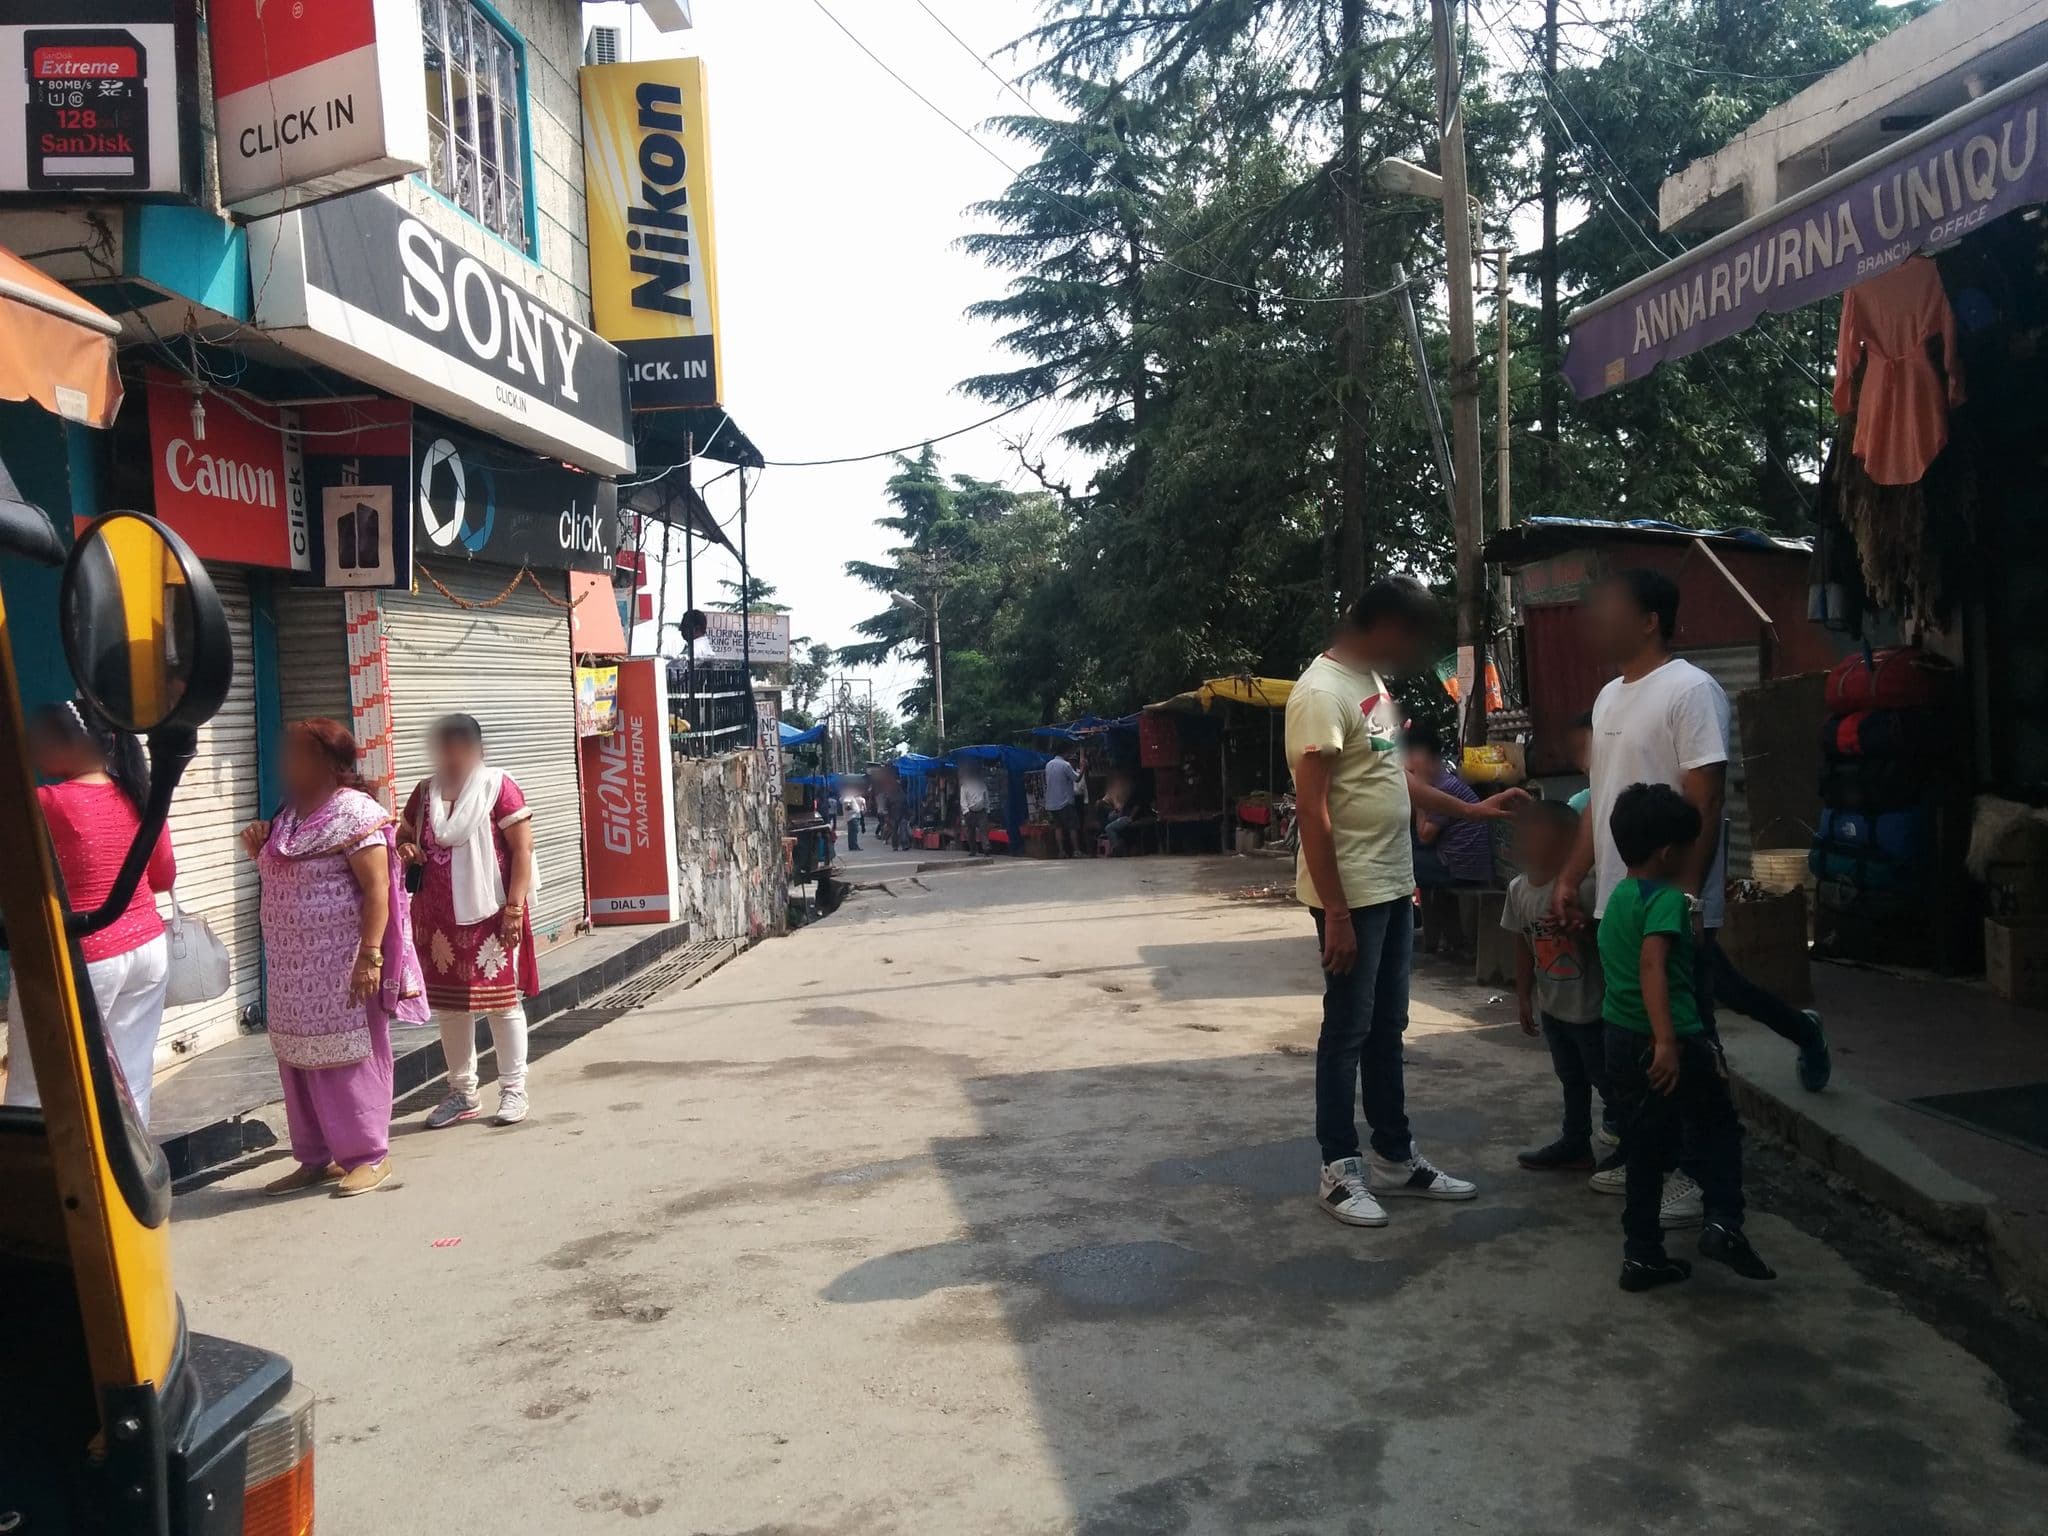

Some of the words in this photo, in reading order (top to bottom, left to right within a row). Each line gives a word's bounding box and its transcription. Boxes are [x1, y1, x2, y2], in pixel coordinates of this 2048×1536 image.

[41, 60, 119, 75] Extreme
[41, 131, 133, 153] SanDisk
[57, 110, 97, 128] 128
[239, 106, 318, 158] CLICK
[326, 94, 354, 131] IN
[626, 81, 692, 318] Nikon
[1856, 240, 1912, 275] BRANCH
[1929, 204, 1988, 243] OFFICE
[1632, 200, 1865, 355] ANNARPURNA
[397, 218, 583, 403] SONY
[684, 360, 707, 379] IN
[165, 438, 276, 508] Canon
[288, 467, 306, 556] Click
[732, 639, 754, 647] HEE
[630, 715, 647, 777] PHONE
[631, 778, 650, 849] SMART
[610, 899, 637, 911] DIAL
[638, 899, 647, 910] 9
